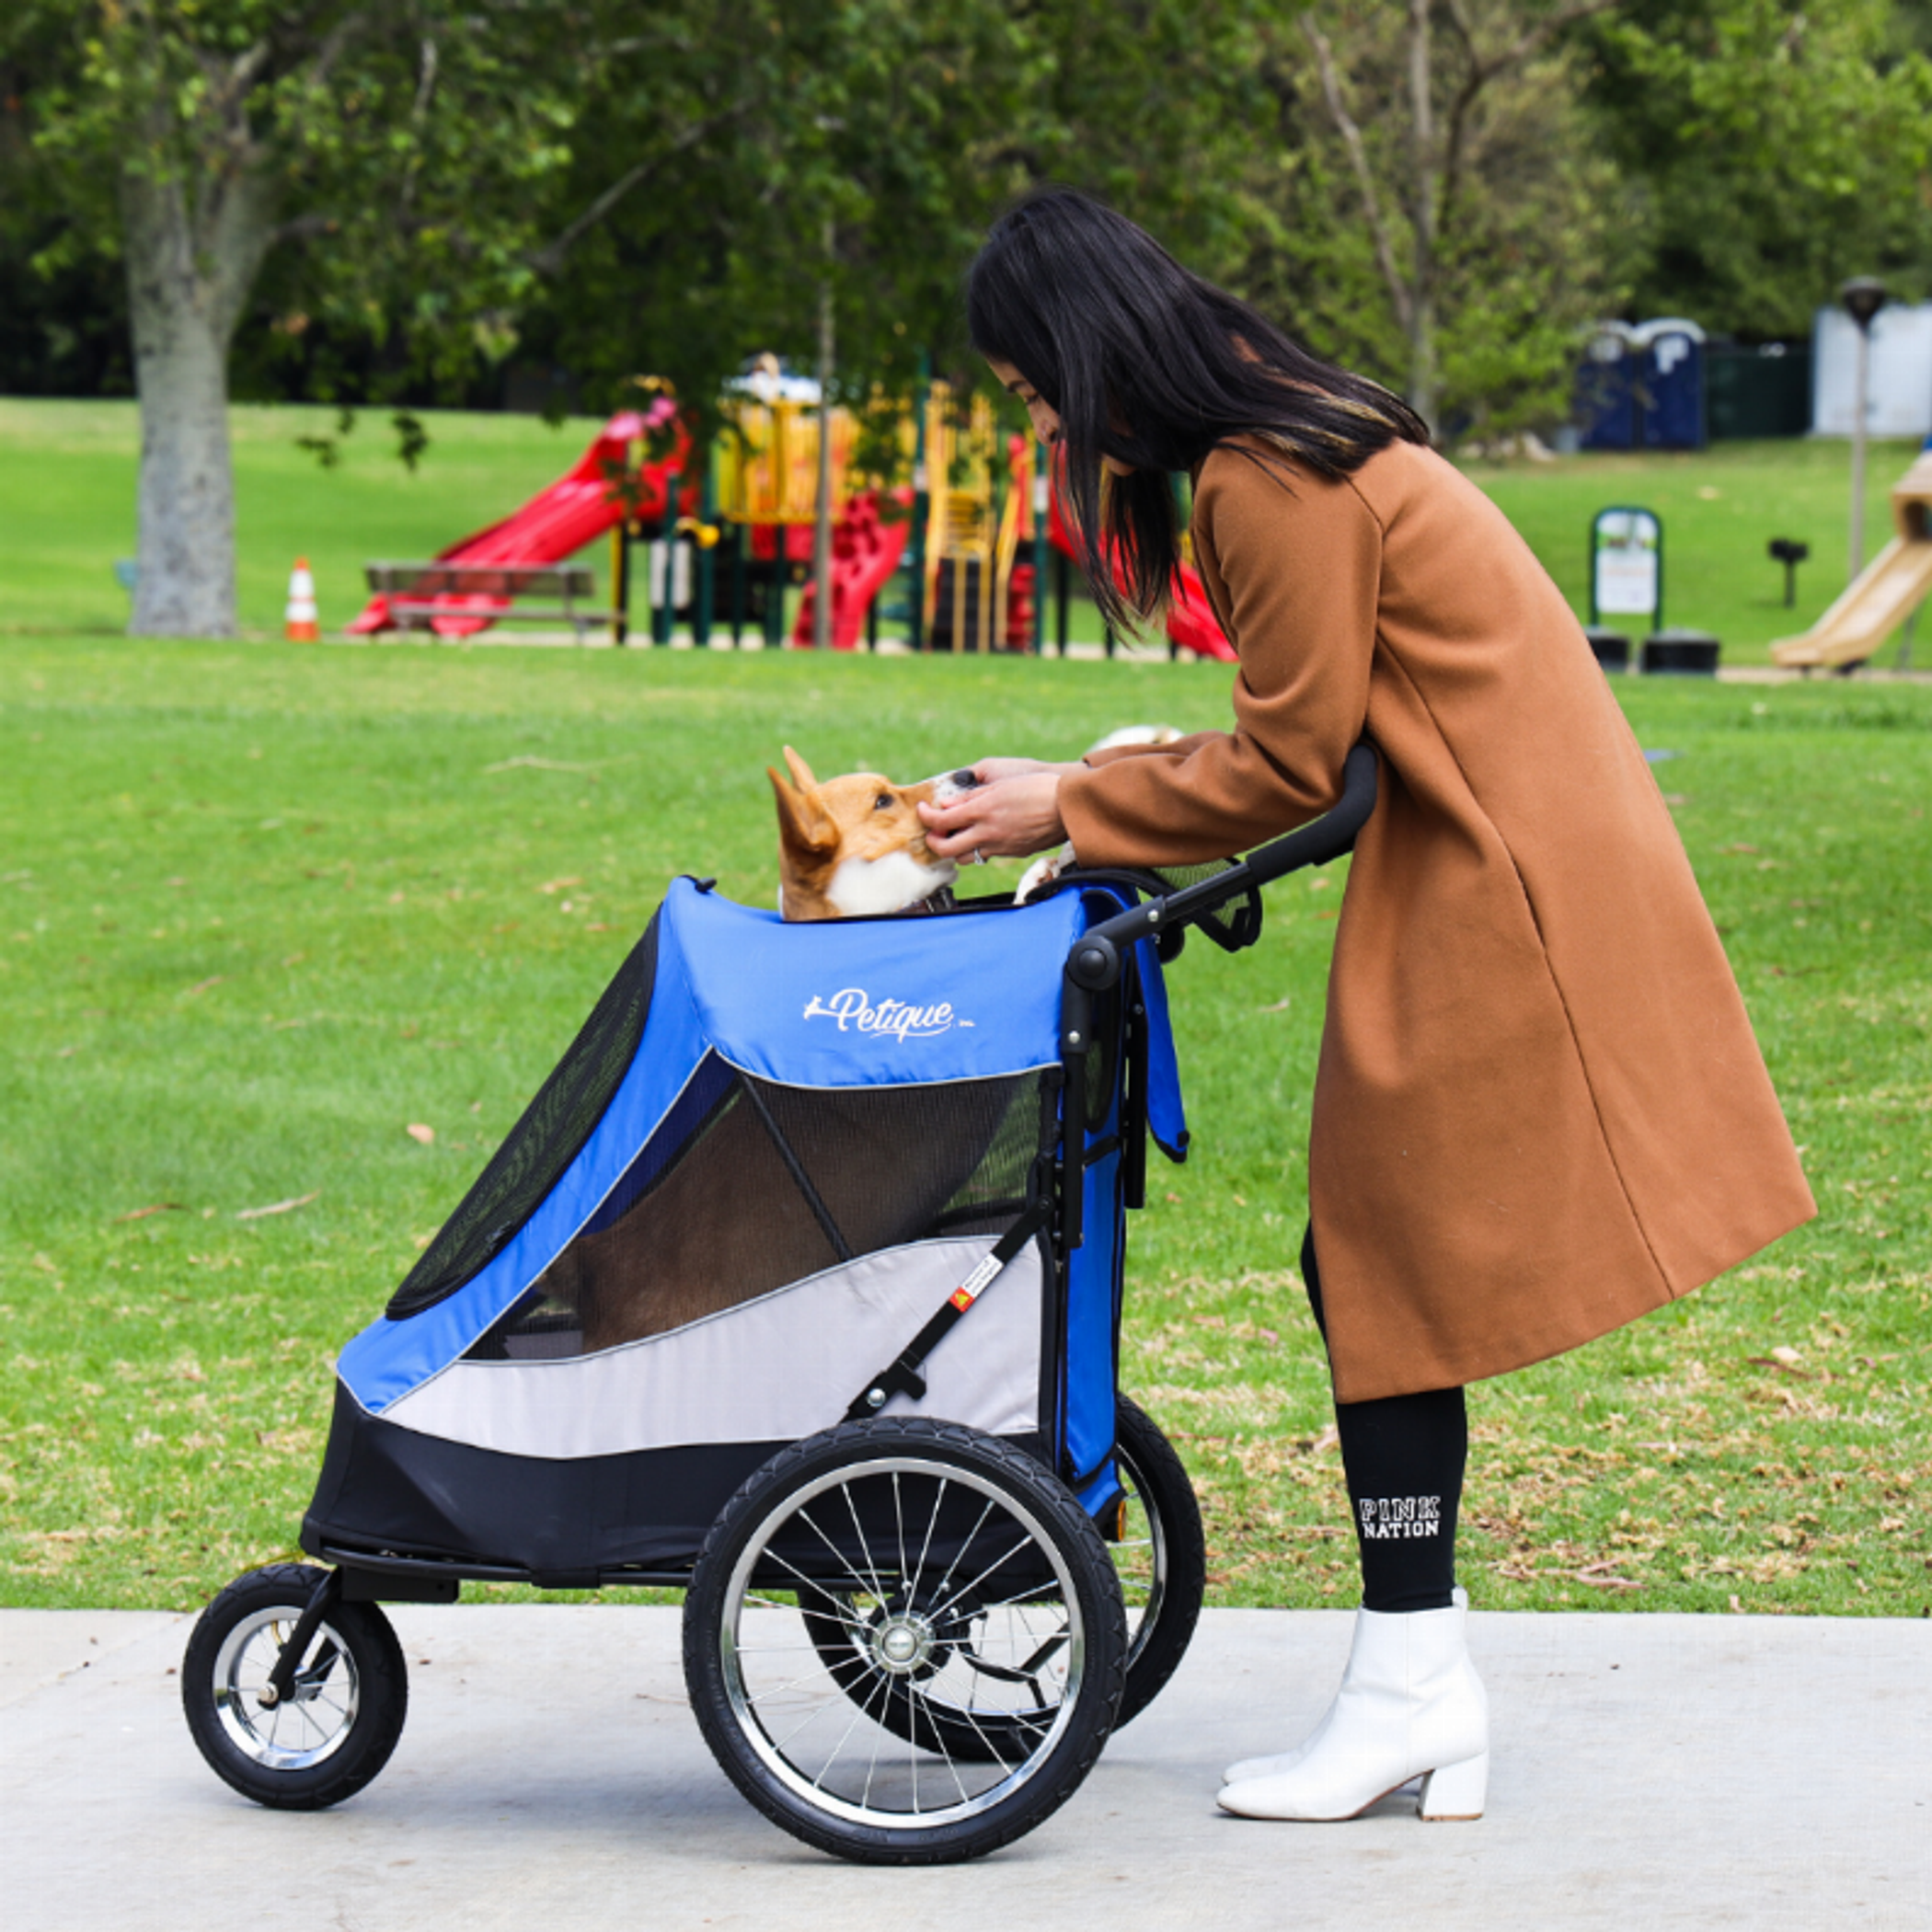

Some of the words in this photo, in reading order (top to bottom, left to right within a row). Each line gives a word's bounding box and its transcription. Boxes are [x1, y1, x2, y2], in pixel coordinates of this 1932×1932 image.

[826, 987, 954, 1044] Petique
[1359, 1496, 1441, 1522] PINK
[1362, 1521, 1439, 1539] NATION
